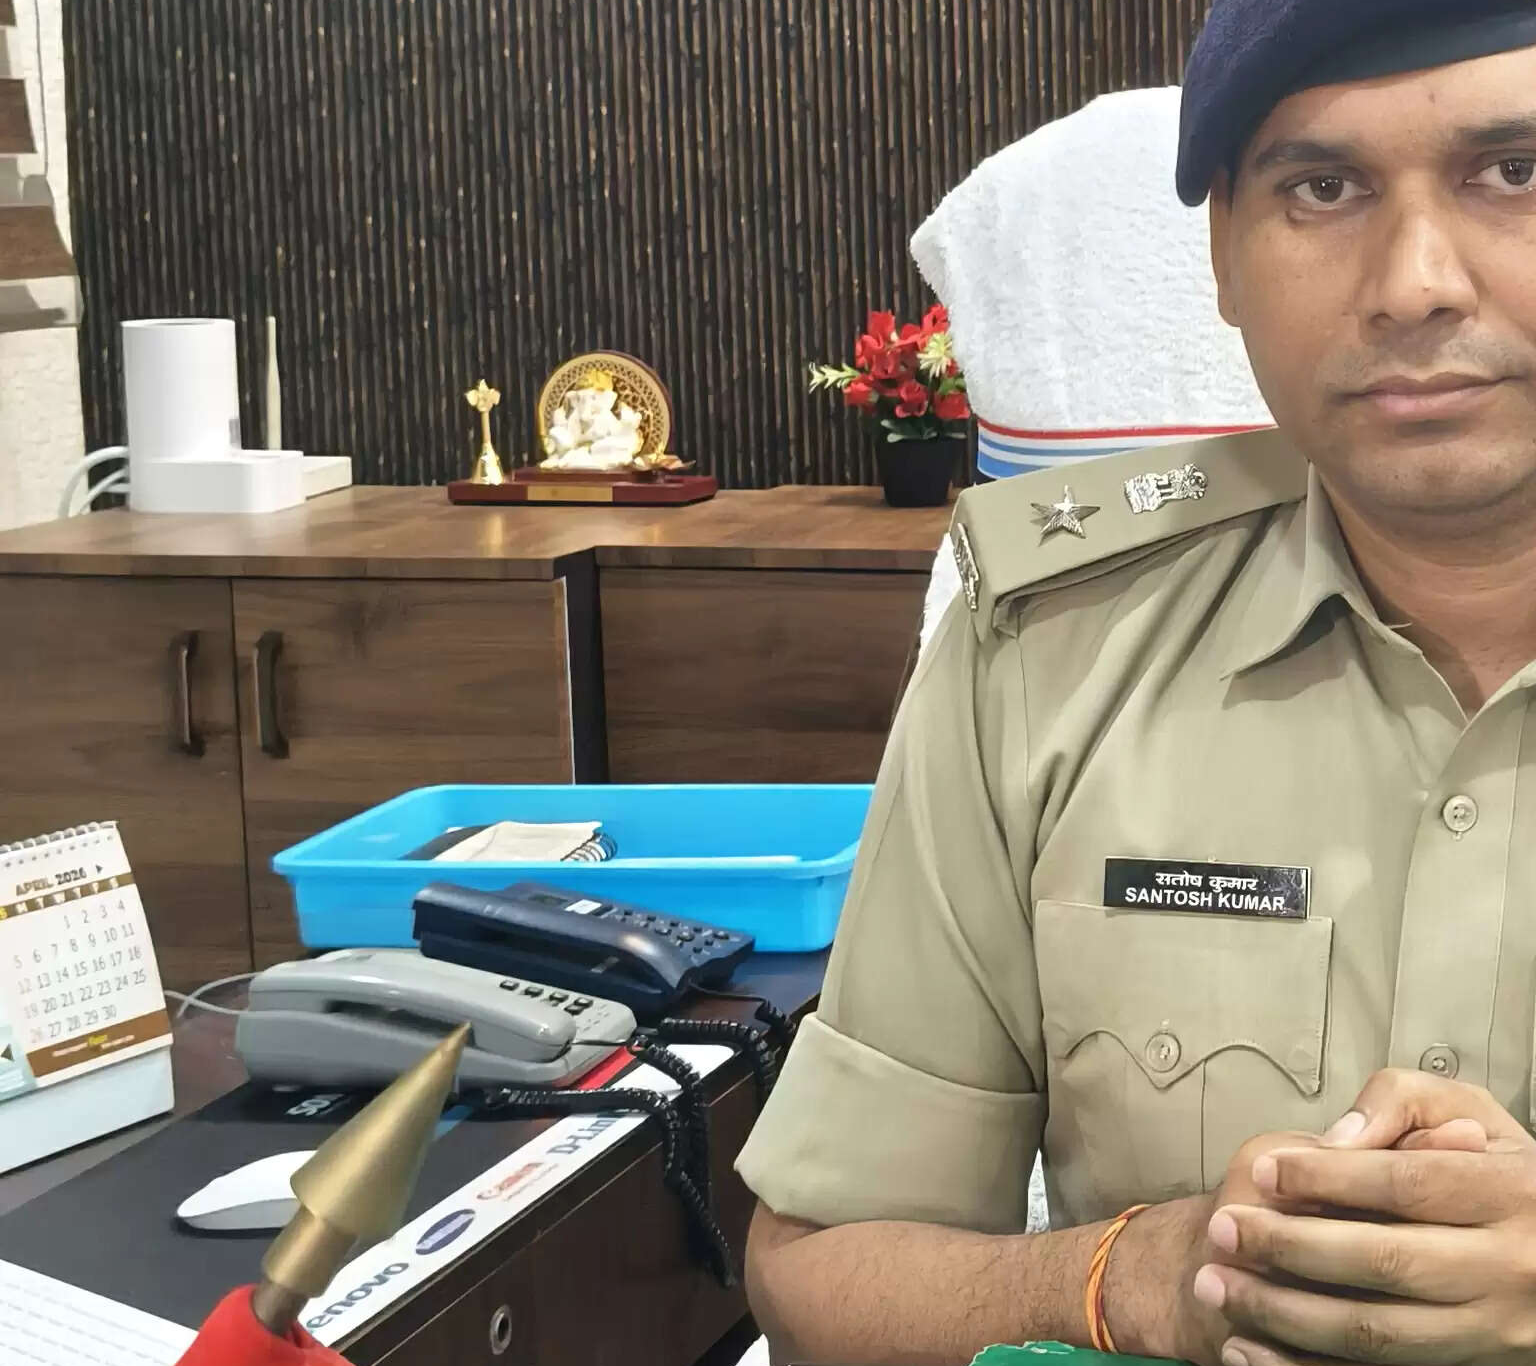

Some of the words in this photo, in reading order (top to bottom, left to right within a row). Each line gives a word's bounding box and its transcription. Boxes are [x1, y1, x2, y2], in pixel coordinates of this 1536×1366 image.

[55, 867, 88, 885] 2026
[1208, 875, 1259, 893] कुमार
[81, 910, 90, 924] 2
[100, 905, 109, 919] 3
[117, 899, 126, 912] 4
[1124, 886, 1213, 908] SANTOSH
[1218, 891, 1285, 912] KUMAR
[104, 927, 118, 943] 10
[122, 922, 135, 938] 11
[37, 973, 51, 989] 13
[56, 967, 70, 983] 14
[74, 961, 88, 977] 15
[92, 955, 106, 972] 16
[110, 951, 123, 967] 17
[42, 996, 58, 1013] 20
[60, 991, 75, 1008] 21
[79, 986, 94, 1001] 22
[97, 980, 112, 996] 23
[115, 975, 129, 991] 24
[133, 969, 147, 985] 25
[48, 1021, 62, 1038] 27
[84, 1010, 99, 1026] 29
[102, 1004, 117, 1020] 30
[546, 1111, 624, 1154] D-Lin
[305, 1262, 410, 1332] enovo
